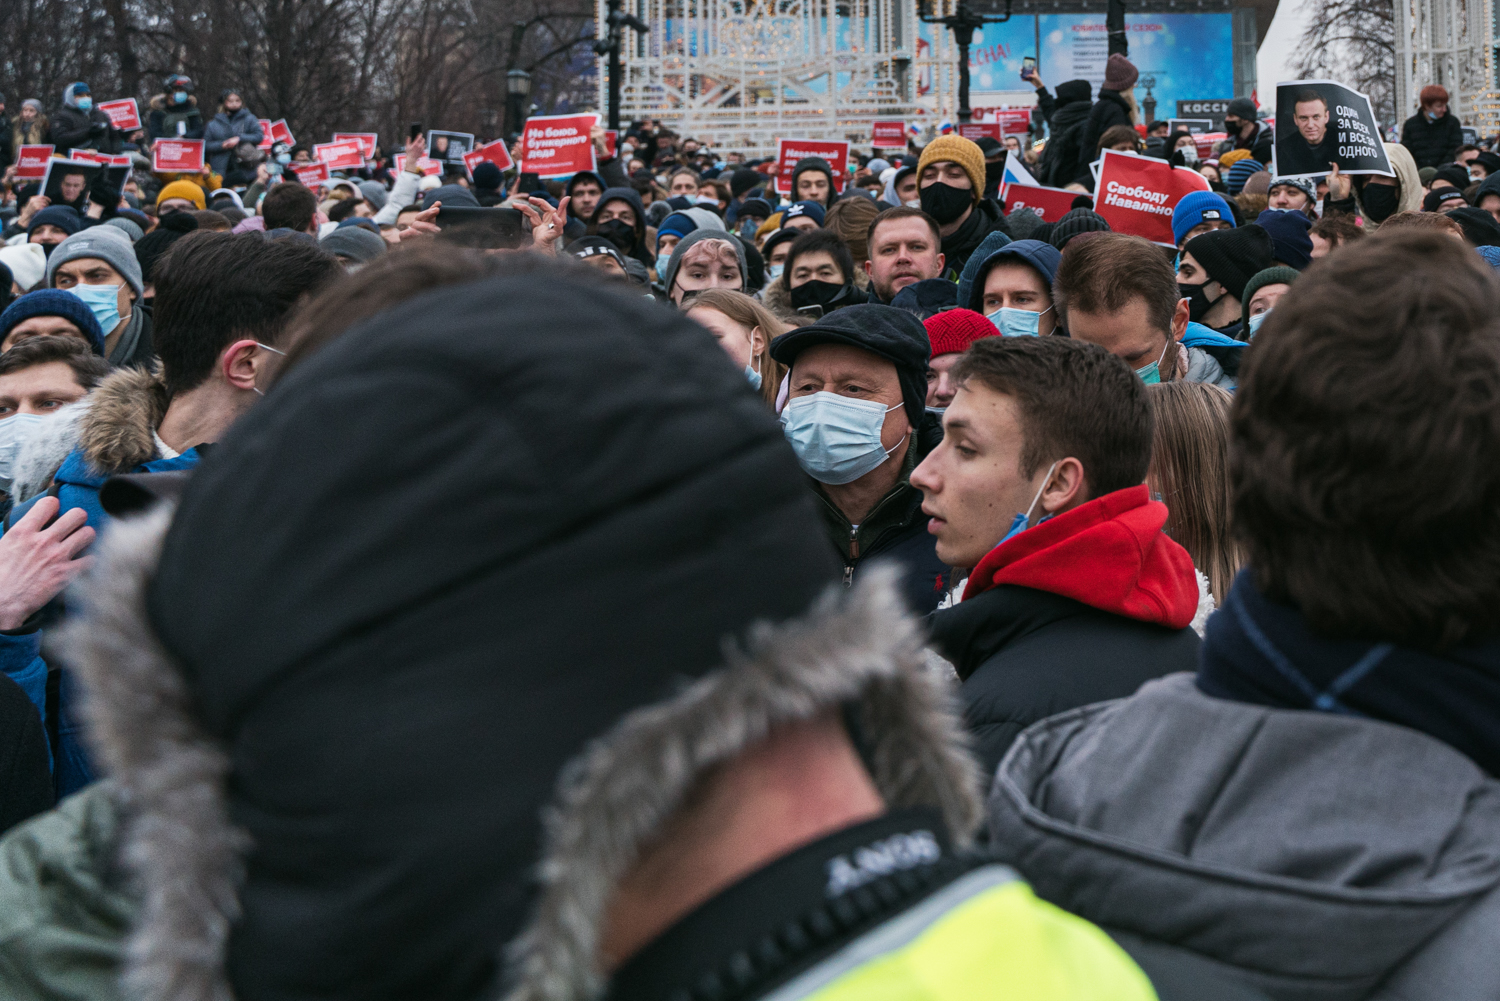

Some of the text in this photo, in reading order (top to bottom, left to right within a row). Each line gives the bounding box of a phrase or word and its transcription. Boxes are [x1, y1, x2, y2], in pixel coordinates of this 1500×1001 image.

[1336, 105, 1359, 119] ОДИН
[527, 127, 578, 138] Не боюсь
[1337, 118, 1371, 135] ЗА ВСЕХ
[527, 135, 587, 149] бункерного
[1338, 132, 1377, 148] И ВСЕ ЗА
[527, 149, 555, 159] деда
[1338, 146, 1378, 159] ОДНОГО
[1107, 181, 1169, 205] Свободу
[1010, 201, 1025, 213] Я
[1104, 193, 1175, 217] Навально
